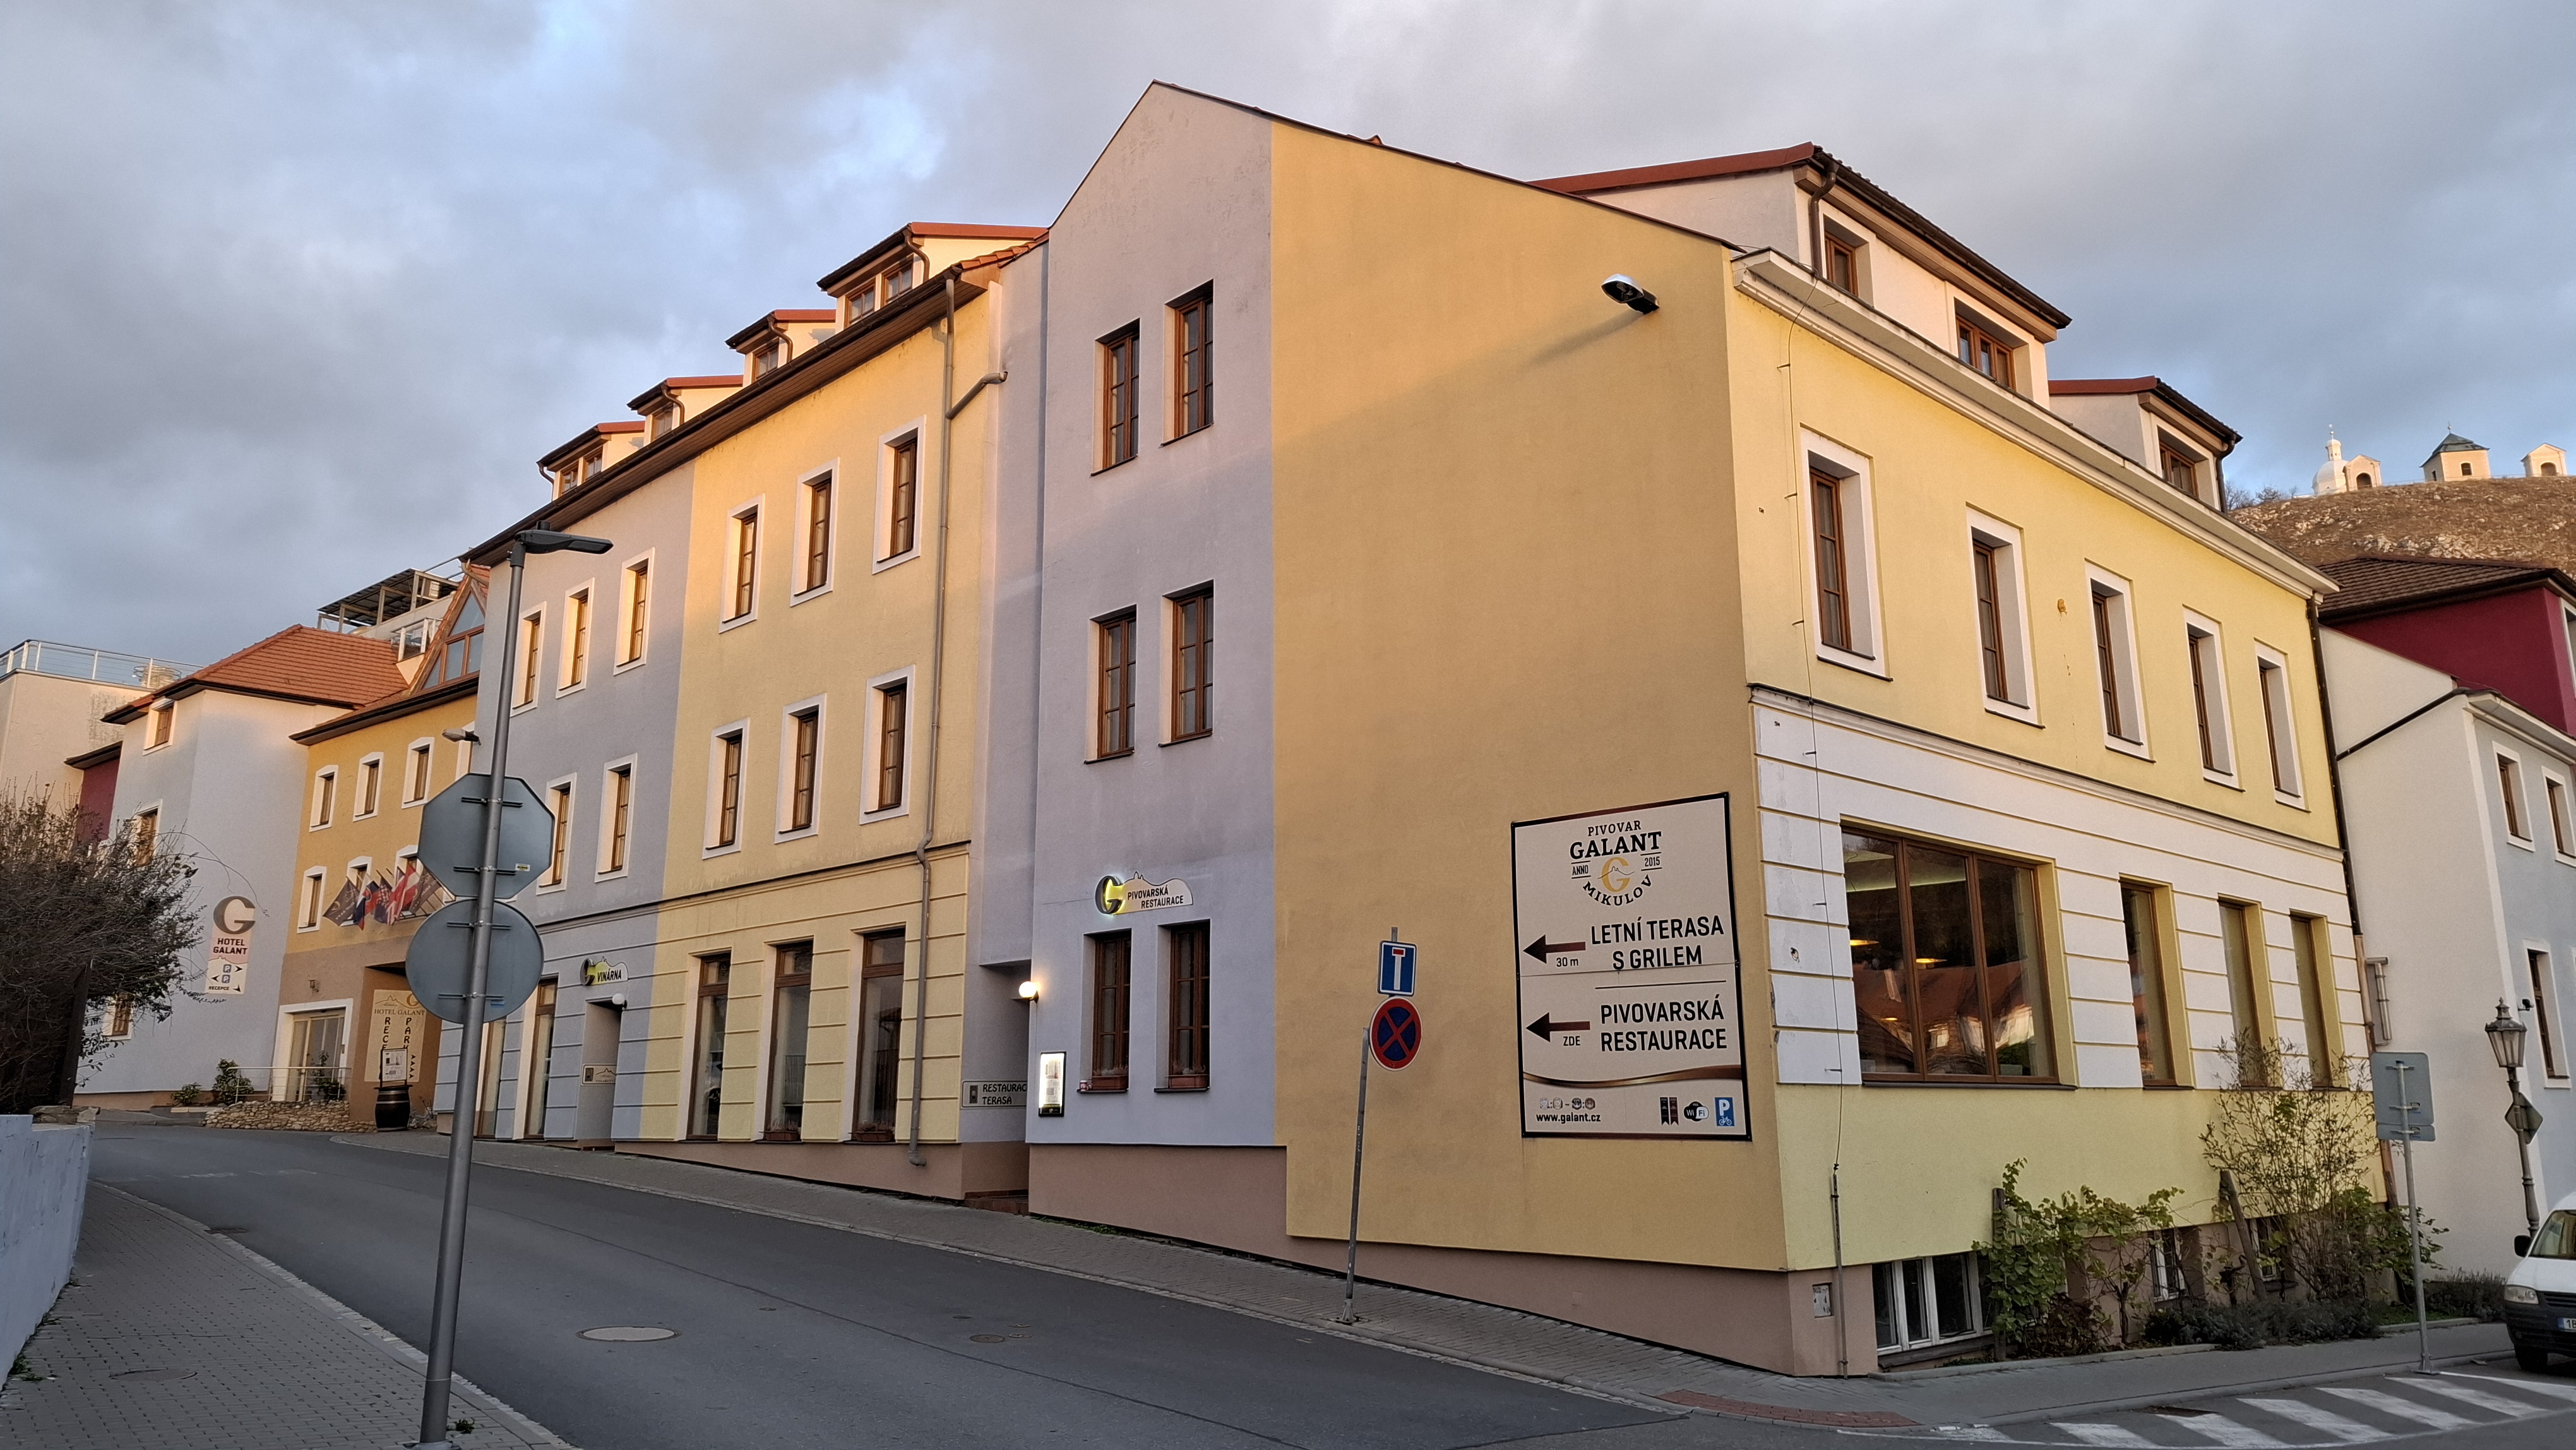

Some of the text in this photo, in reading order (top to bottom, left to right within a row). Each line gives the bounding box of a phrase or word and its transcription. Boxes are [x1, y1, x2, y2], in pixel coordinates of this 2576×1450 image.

[1587, 820, 1642, 837] PIVOVAR
[1570, 830, 1662, 860] GALANT
[1644, 856, 1661, 867] 2015
[1571, 865, 1589, 876] ANNO
[1127, 884, 1169, 901] PIVOVARSKÁ
[1582, 873, 1652, 906] MIKULOV
[1141, 895, 1184, 909] RESTAURACE
[213, 895, 256, 935] G
[1591, 914, 1724, 945] LETNÍ TERASA
[217, 937, 246, 946] HOTEL
[213, 946, 248, 955] GALANT
[1613, 944, 1703, 970] S GRILEM
[1556, 957, 1579, 968] 30 m
[597, 968, 622, 983] VINÁRNA
[1601, 993, 1725, 1024] PIVOVARSKÁ
[1563, 1035, 1581, 1046] ZDE
[1601, 1028, 1727, 1052] RESTAURACE
[982, 1096, 1012, 1105] TERASA
[1535, 1111, 1601, 1124] www.galant.cz
